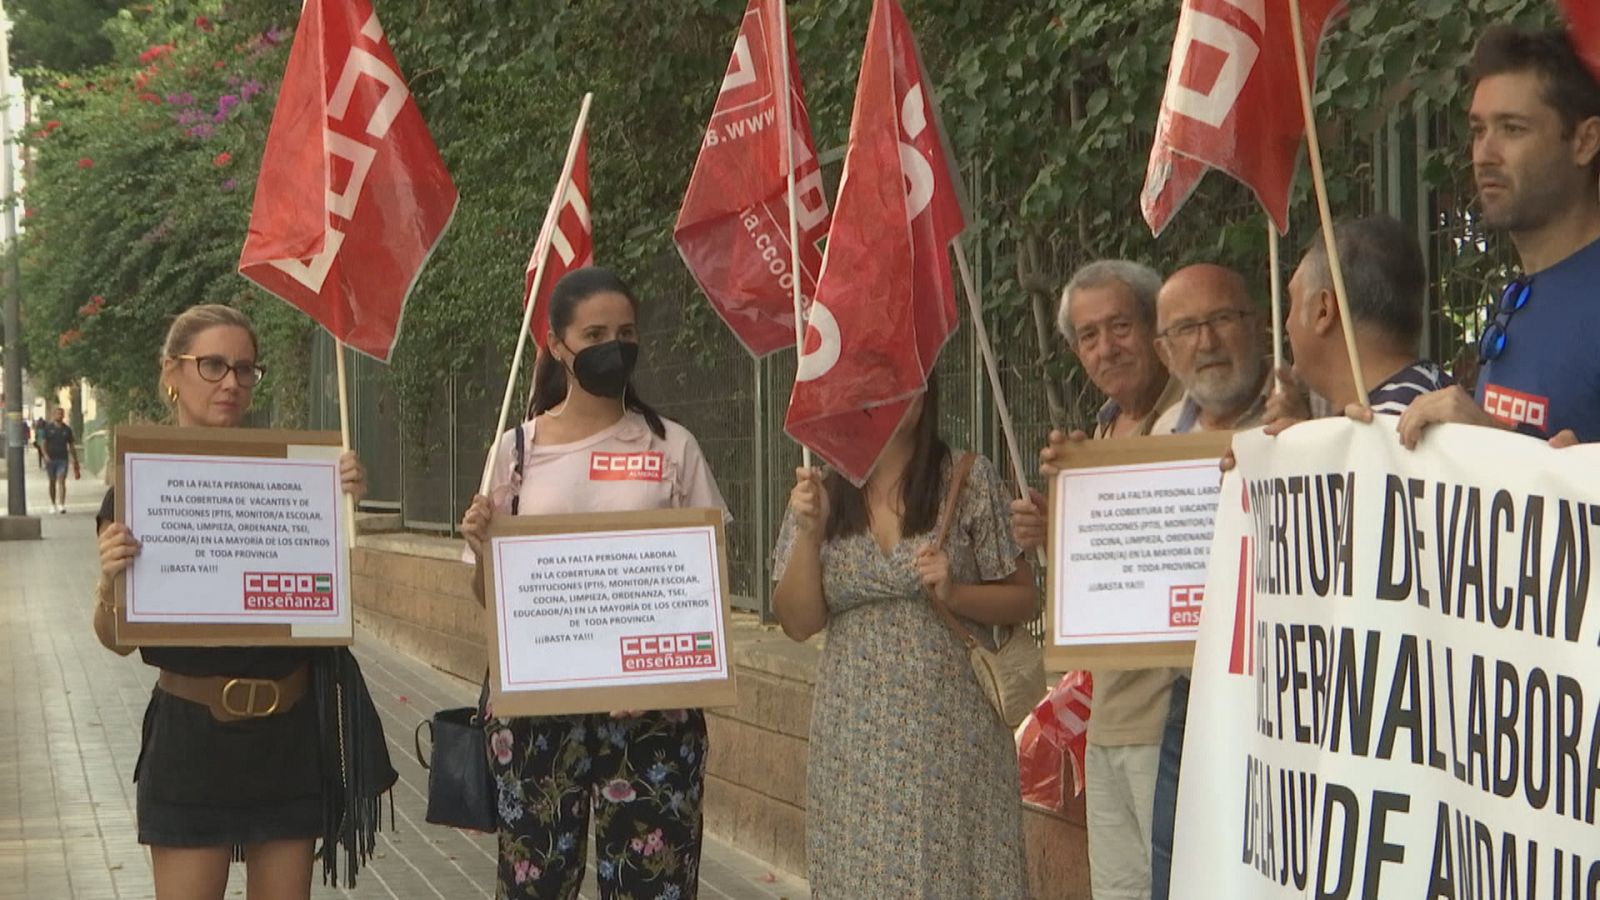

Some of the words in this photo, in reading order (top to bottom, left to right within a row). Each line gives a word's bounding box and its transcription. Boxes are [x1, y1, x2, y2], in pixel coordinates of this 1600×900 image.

[1484, 390, 1545, 426] CCOO
[592, 455, 660, 471] CCOO
[224, 481, 265, 490] PERSONAL
[267, 483, 301, 491] LABORAL
[185, 496, 233, 504] COBERTURA
[235, 497, 245, 505] DE
[249, 498, 290, 506] VACANTES
[147, 508, 210, 517] SUSTITUCIONES
[212, 510, 233, 518] (PTIS,
[236, 511, 284, 520] MONITOR/A
[286, 512, 322, 520] ESCOLAR,
[161, 522, 194, 530] COCINA,
[196, 522, 236, 532] LIMPIEZA,
[238, 524, 289, 533] ORDENANZA,
[292, 525, 310, 534] TSEI,
[141, 535, 199, 545] EDUCADOR/A)
[225, 537, 263, 545] MAYORÍA
[278, 538, 292, 546] LOS
[295, 538, 330, 546] CENTROS
[1376, 473, 1430, 608] DE
[195, 549, 205, 557] DE
[235, 550, 278, 559] PROVINCIA
[556, 556, 567, 564] LA
[568, 555, 593, 563] FALTA
[596, 552, 638, 561] PERSONAL
[640, 550, 677, 559] LABORAL
[531, 572, 542, 580] EN
[556, 569, 606, 578] COBERTURA
[622, 565, 665, 575] VACANTES
[675, 564, 684, 572] DE
[246, 574, 313, 592] CCOO
[519, 581, 582, 593] SUSTITUCIONES
[585, 581, 606, 590] (PTIS,
[608, 577, 659, 588] MONITOR/A
[661, 576, 700, 585] ESCOLAR,
[248, 592, 329, 608] enseñanza
[533, 596, 567, 604] COCINA,
[569, 593, 609, 602] LIMPIEZA,
[612, 590, 665, 599] ORDENANZA,
[668, 589, 687, 597] TSEI,
[513, 607, 573, 618] EDUCADOR/A)
[575, 606, 585, 614] EN
[600, 602, 639, 612] MAYORÍA
[642, 603, 652, 611] DE
[655, 602, 669, 610] LOS
[672, 599, 709, 608] CENTROS
[585, 618, 608, 626] TODA
[610, 615, 655, 624] PROVINCIA
[622, 635, 693, 655] CCOO
[626, 654, 711, 669] enseñanza
